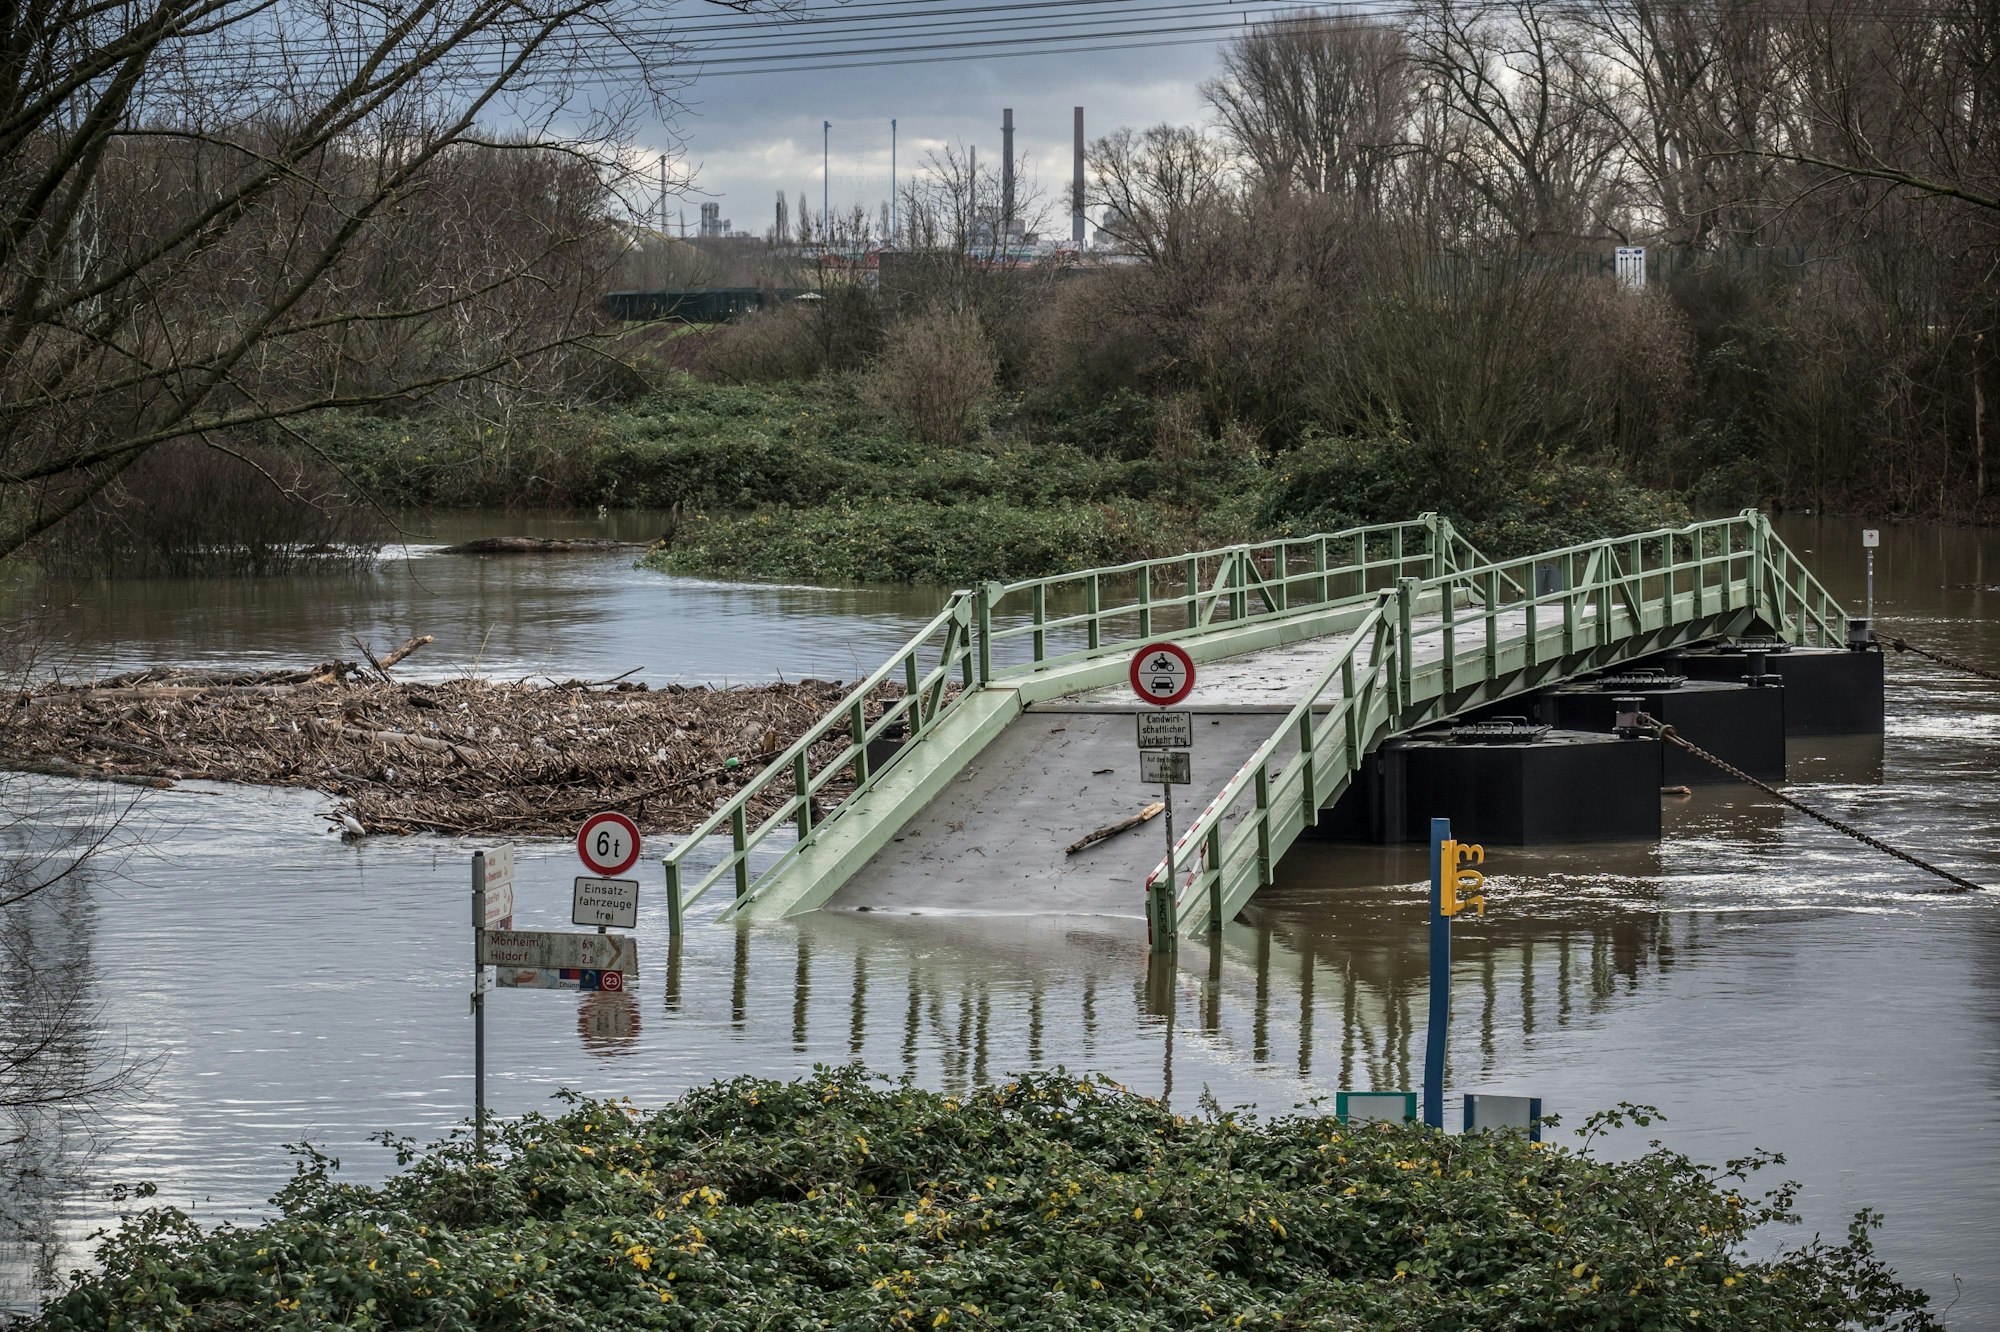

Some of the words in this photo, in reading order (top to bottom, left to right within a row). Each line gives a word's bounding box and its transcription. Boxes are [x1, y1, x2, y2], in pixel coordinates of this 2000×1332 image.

[1147, 715, 1183, 724] Landwirt-
[1142, 725, 1186, 734] schaftlicher
[1143, 736, 1172, 744] Verkehr
[1174, 735, 1186, 744] frei
[597, 831, 610, 857] 6
[614, 839, 620, 857] t
[584, 883, 628, 896] Einsatz-
[579, 896, 632, 911] fahrzeuge
[596, 910, 614, 921] frei
[490, 935, 539, 947] Monheim
[490, 950, 528, 962] Hitdorf
[606, 976, 617, 985] 23
